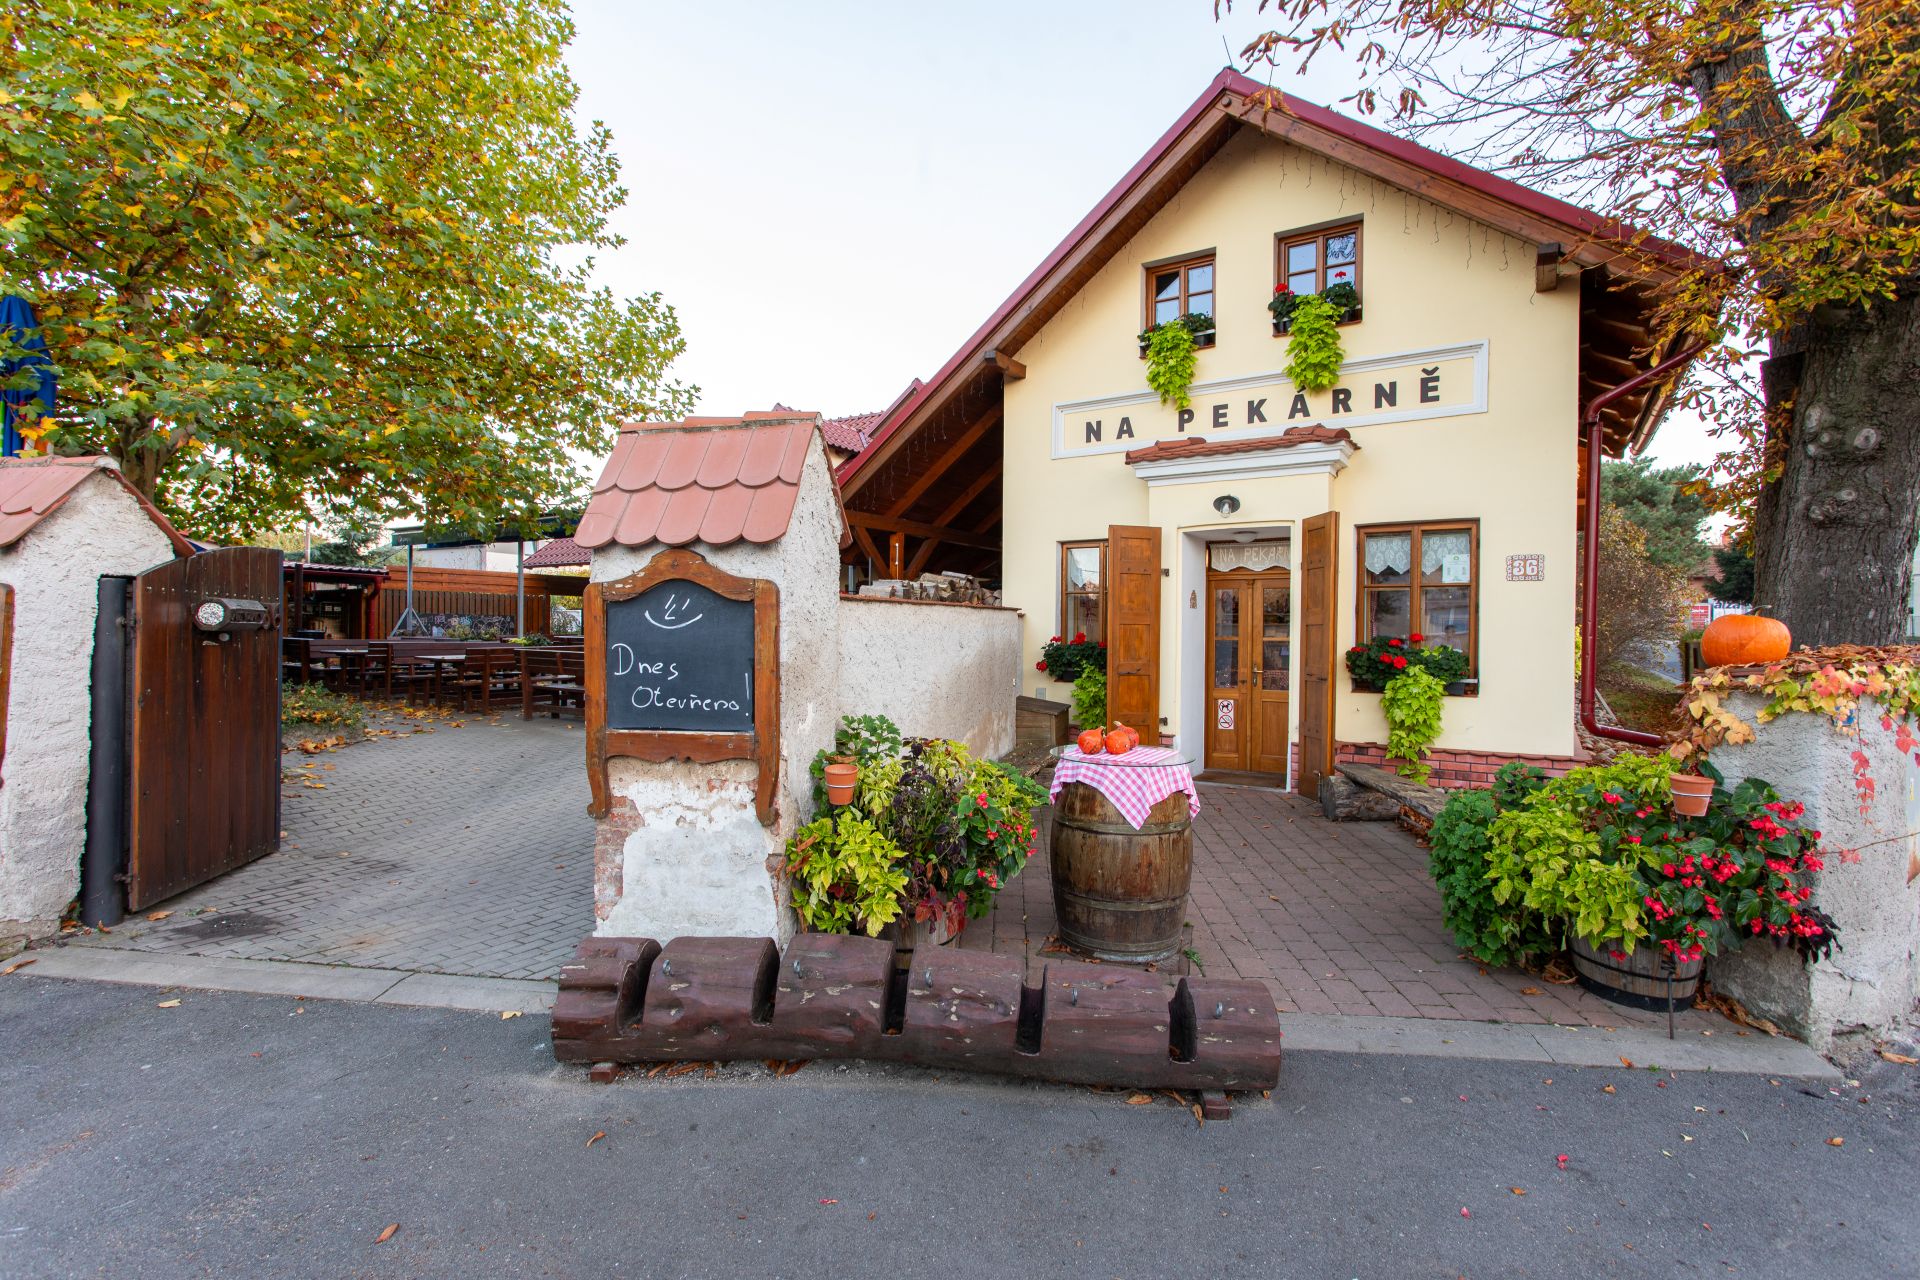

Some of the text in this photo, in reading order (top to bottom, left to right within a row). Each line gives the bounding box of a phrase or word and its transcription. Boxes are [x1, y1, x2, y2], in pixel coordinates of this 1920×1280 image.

[1085, 366, 1441, 443] NA PEKÁRNĚ
[1219, 548, 1236, 562] NA
[611, 643, 679, 680] Dnes
